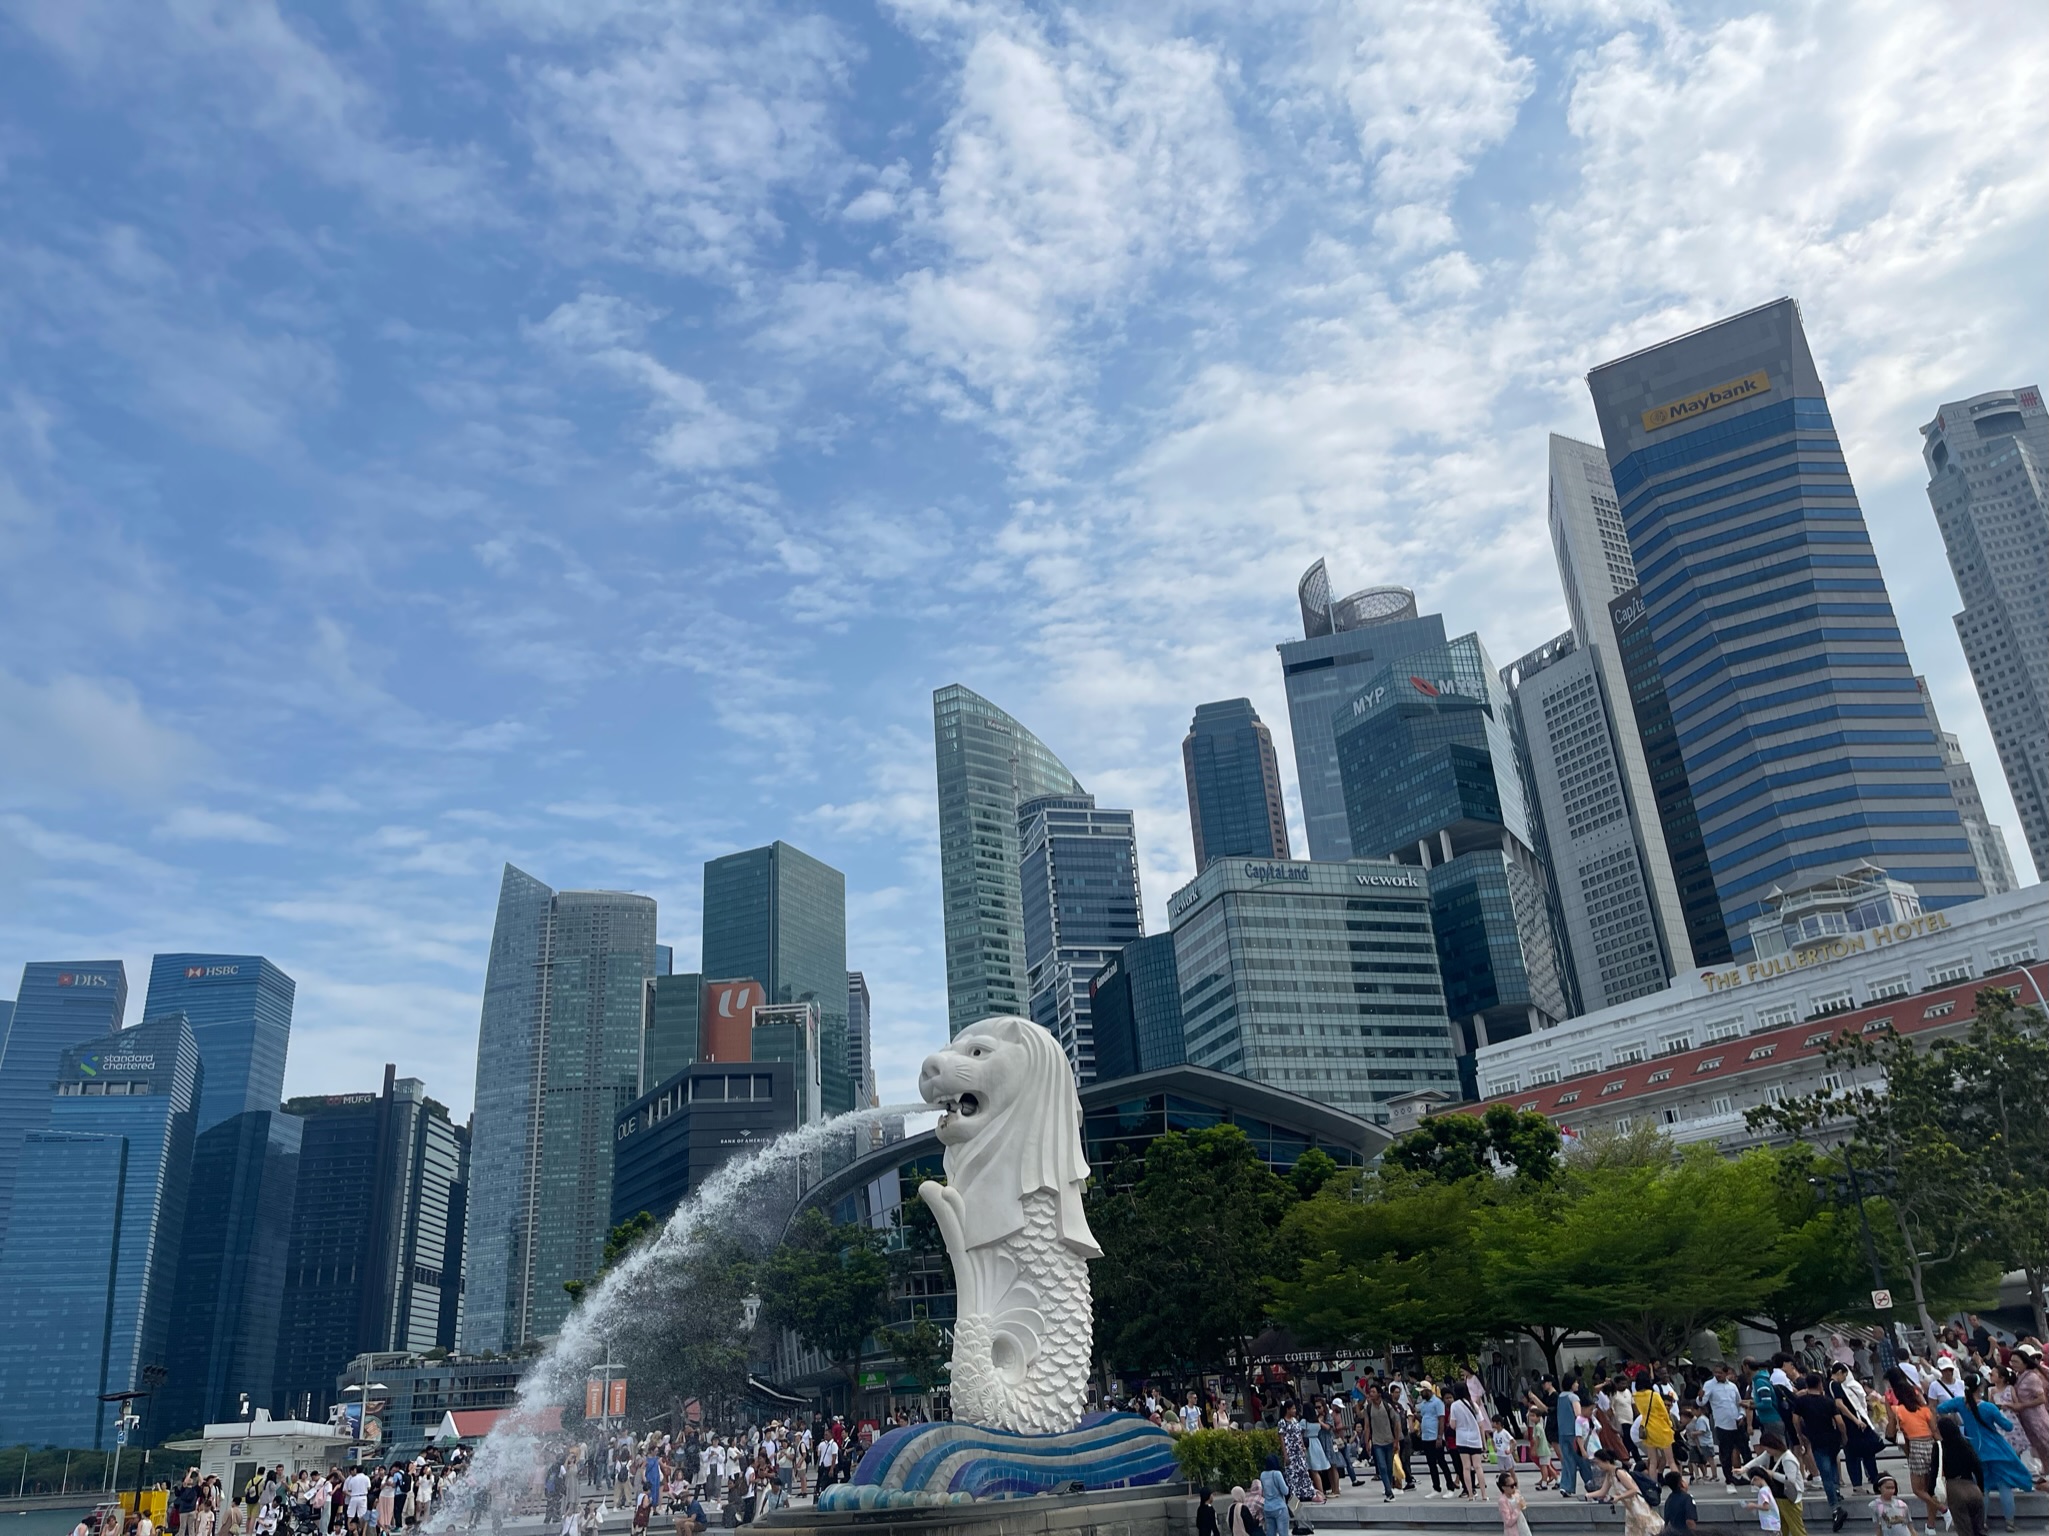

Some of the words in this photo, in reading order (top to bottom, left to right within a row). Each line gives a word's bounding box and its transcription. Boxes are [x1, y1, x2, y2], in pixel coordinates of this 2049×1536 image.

[1669, 380, 1758, 418] Maybank
[1438, 680, 1483, 696] MYP
[1352, 686, 1385, 717] MYP
[1244, 862, 1309, 882] CapitaLand
[1355, 872, 1420, 888] wework
[1703, 969, 1742, 992] THE
[1746, 935, 1866, 981] FULLERTON
[1873, 911, 1951, 946] HOTEL
[206, 965, 239, 976] HSBC
[74, 974, 107, 987] DBS
[102, 1061, 156, 1071] chartered
[103, 1054, 154, 1063] standard
[343, 1095, 372, 1104] MUFG
[617, 1116, 637, 1141] OUE
[1284, 1351, 1322, 1362] COFFEE
[1335, 1348, 1374, 1359] GELATO
